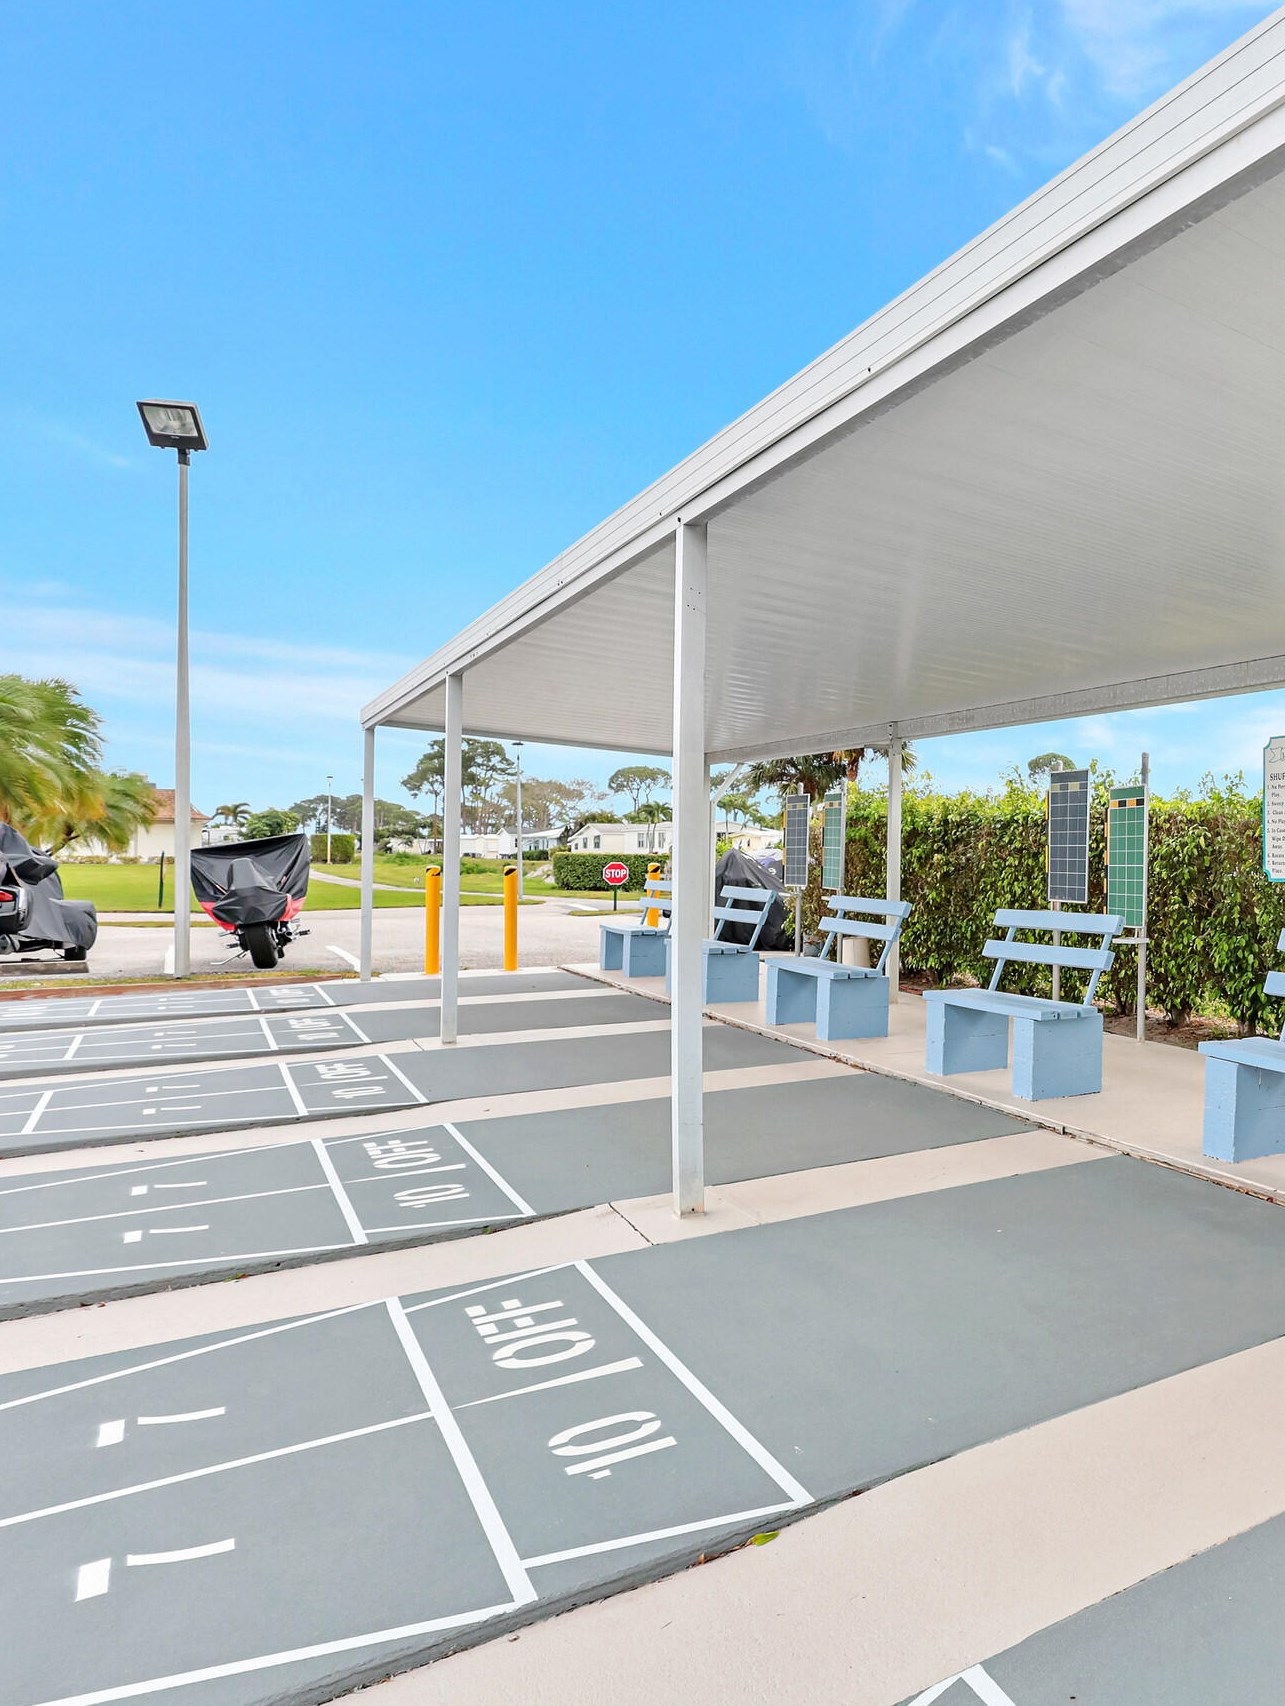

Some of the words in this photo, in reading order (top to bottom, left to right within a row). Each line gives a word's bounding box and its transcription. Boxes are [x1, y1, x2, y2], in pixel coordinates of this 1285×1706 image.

[605, 868, 627, 878] STOP
[314, 1063, 372, 1080] OFF
[331, 1085, 387, 1100] 10
[362, 1139, 441, 1169] OFF
[392, 1184, 470, 1209] 10
[465, 1299, 596, 1369] OFF
[547, 1411, 678, 1480] 10
